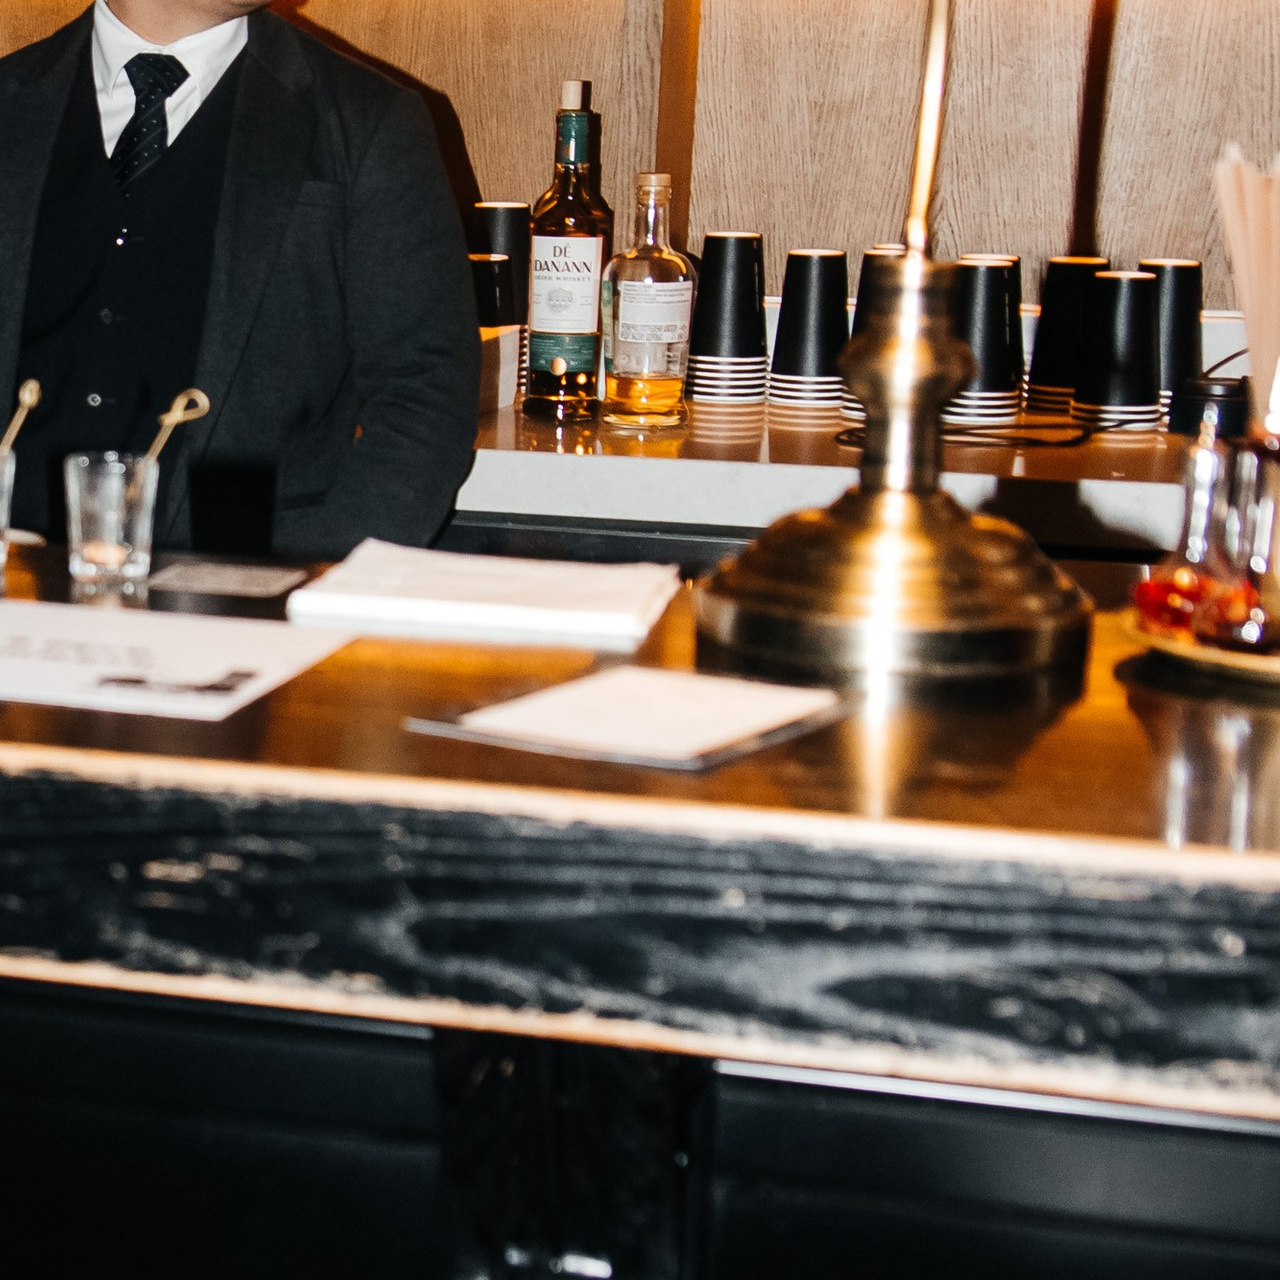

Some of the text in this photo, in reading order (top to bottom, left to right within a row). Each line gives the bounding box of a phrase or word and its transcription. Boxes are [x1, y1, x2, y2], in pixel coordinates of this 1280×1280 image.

[552, 241, 573, 259] DÉ
[534, 259, 593, 274] DANANN
[556, 275, 592, 283] WHISKEY
